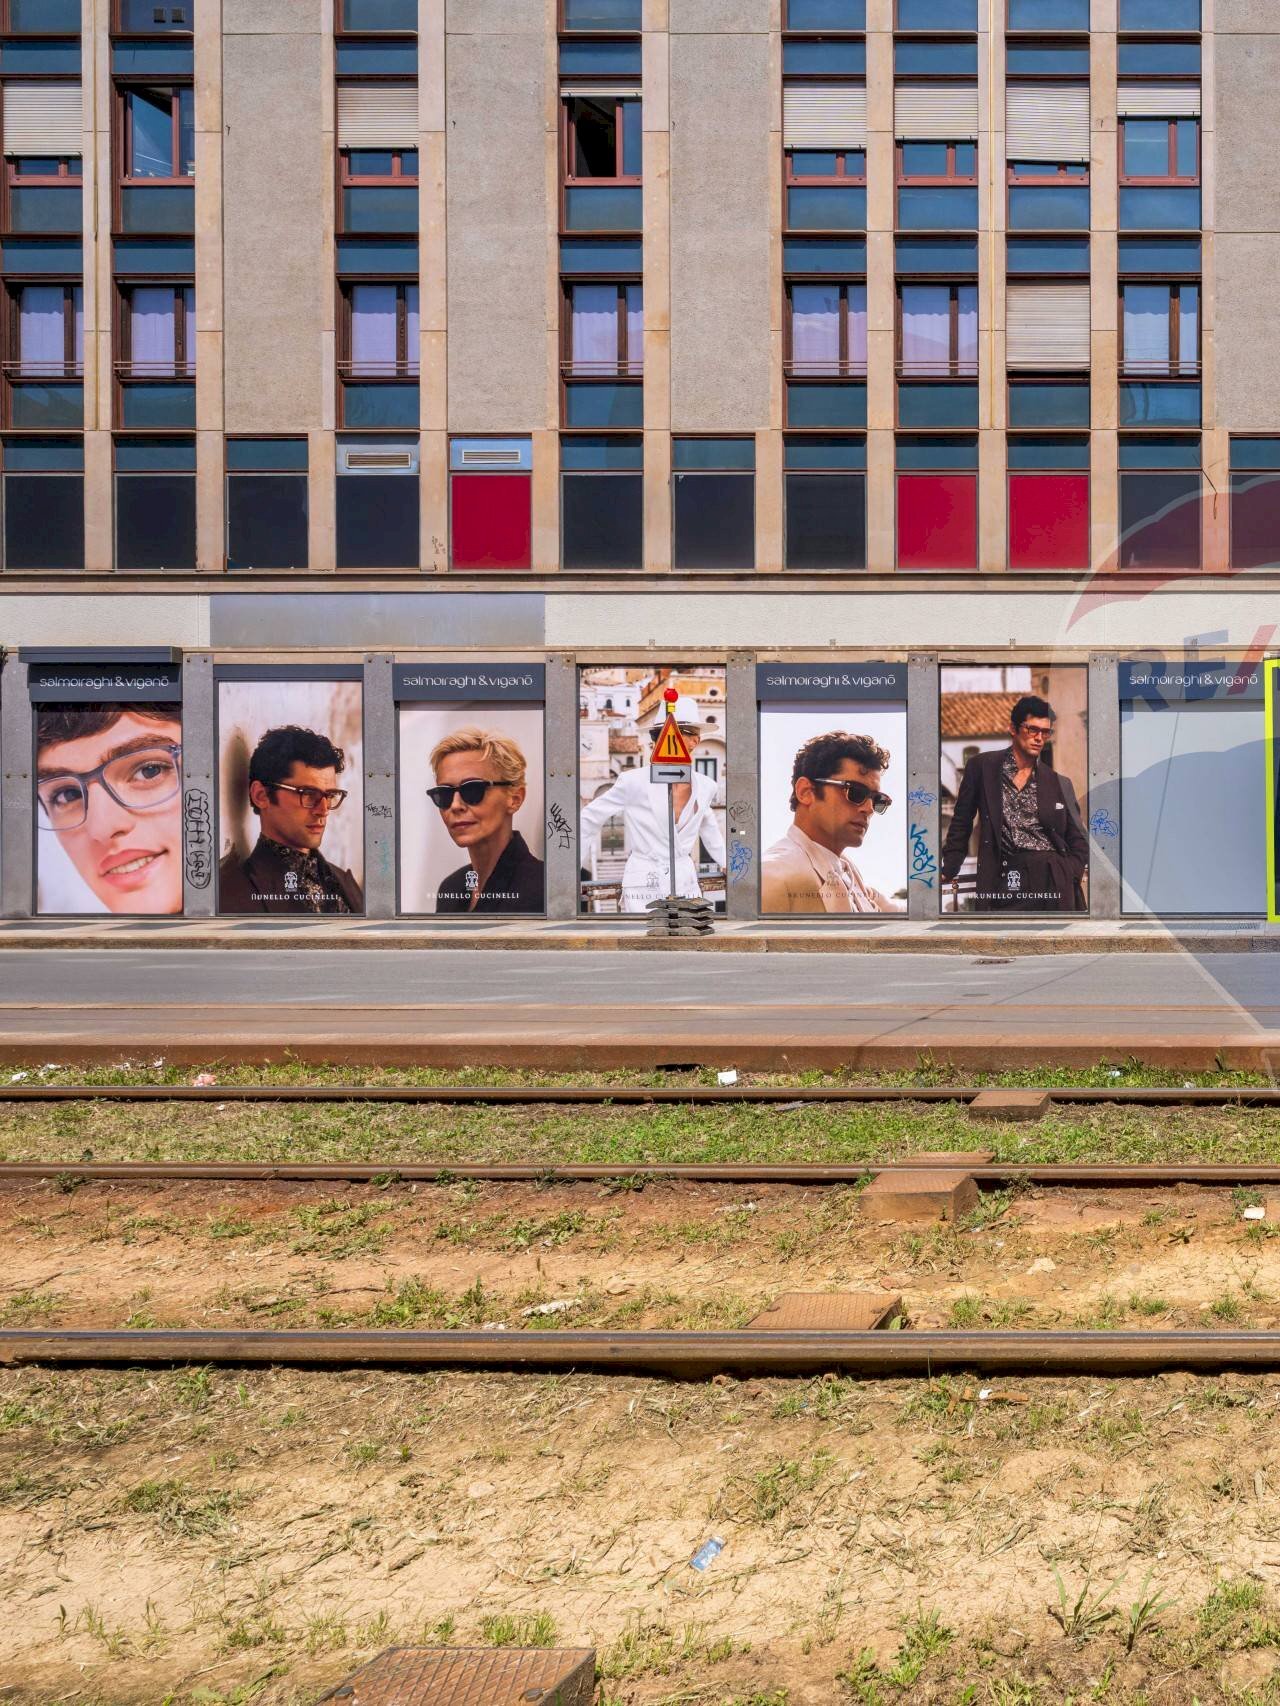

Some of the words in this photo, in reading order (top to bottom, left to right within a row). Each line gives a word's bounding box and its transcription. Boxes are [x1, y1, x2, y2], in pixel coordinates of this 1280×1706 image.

[39, 676, 113, 690] salmoiraghi
[402, 675, 477, 689] salmoiraghi
[766, 675, 840, 688] salmoiraghi
[1129, 674, 1202, 687] salmoiraghi
